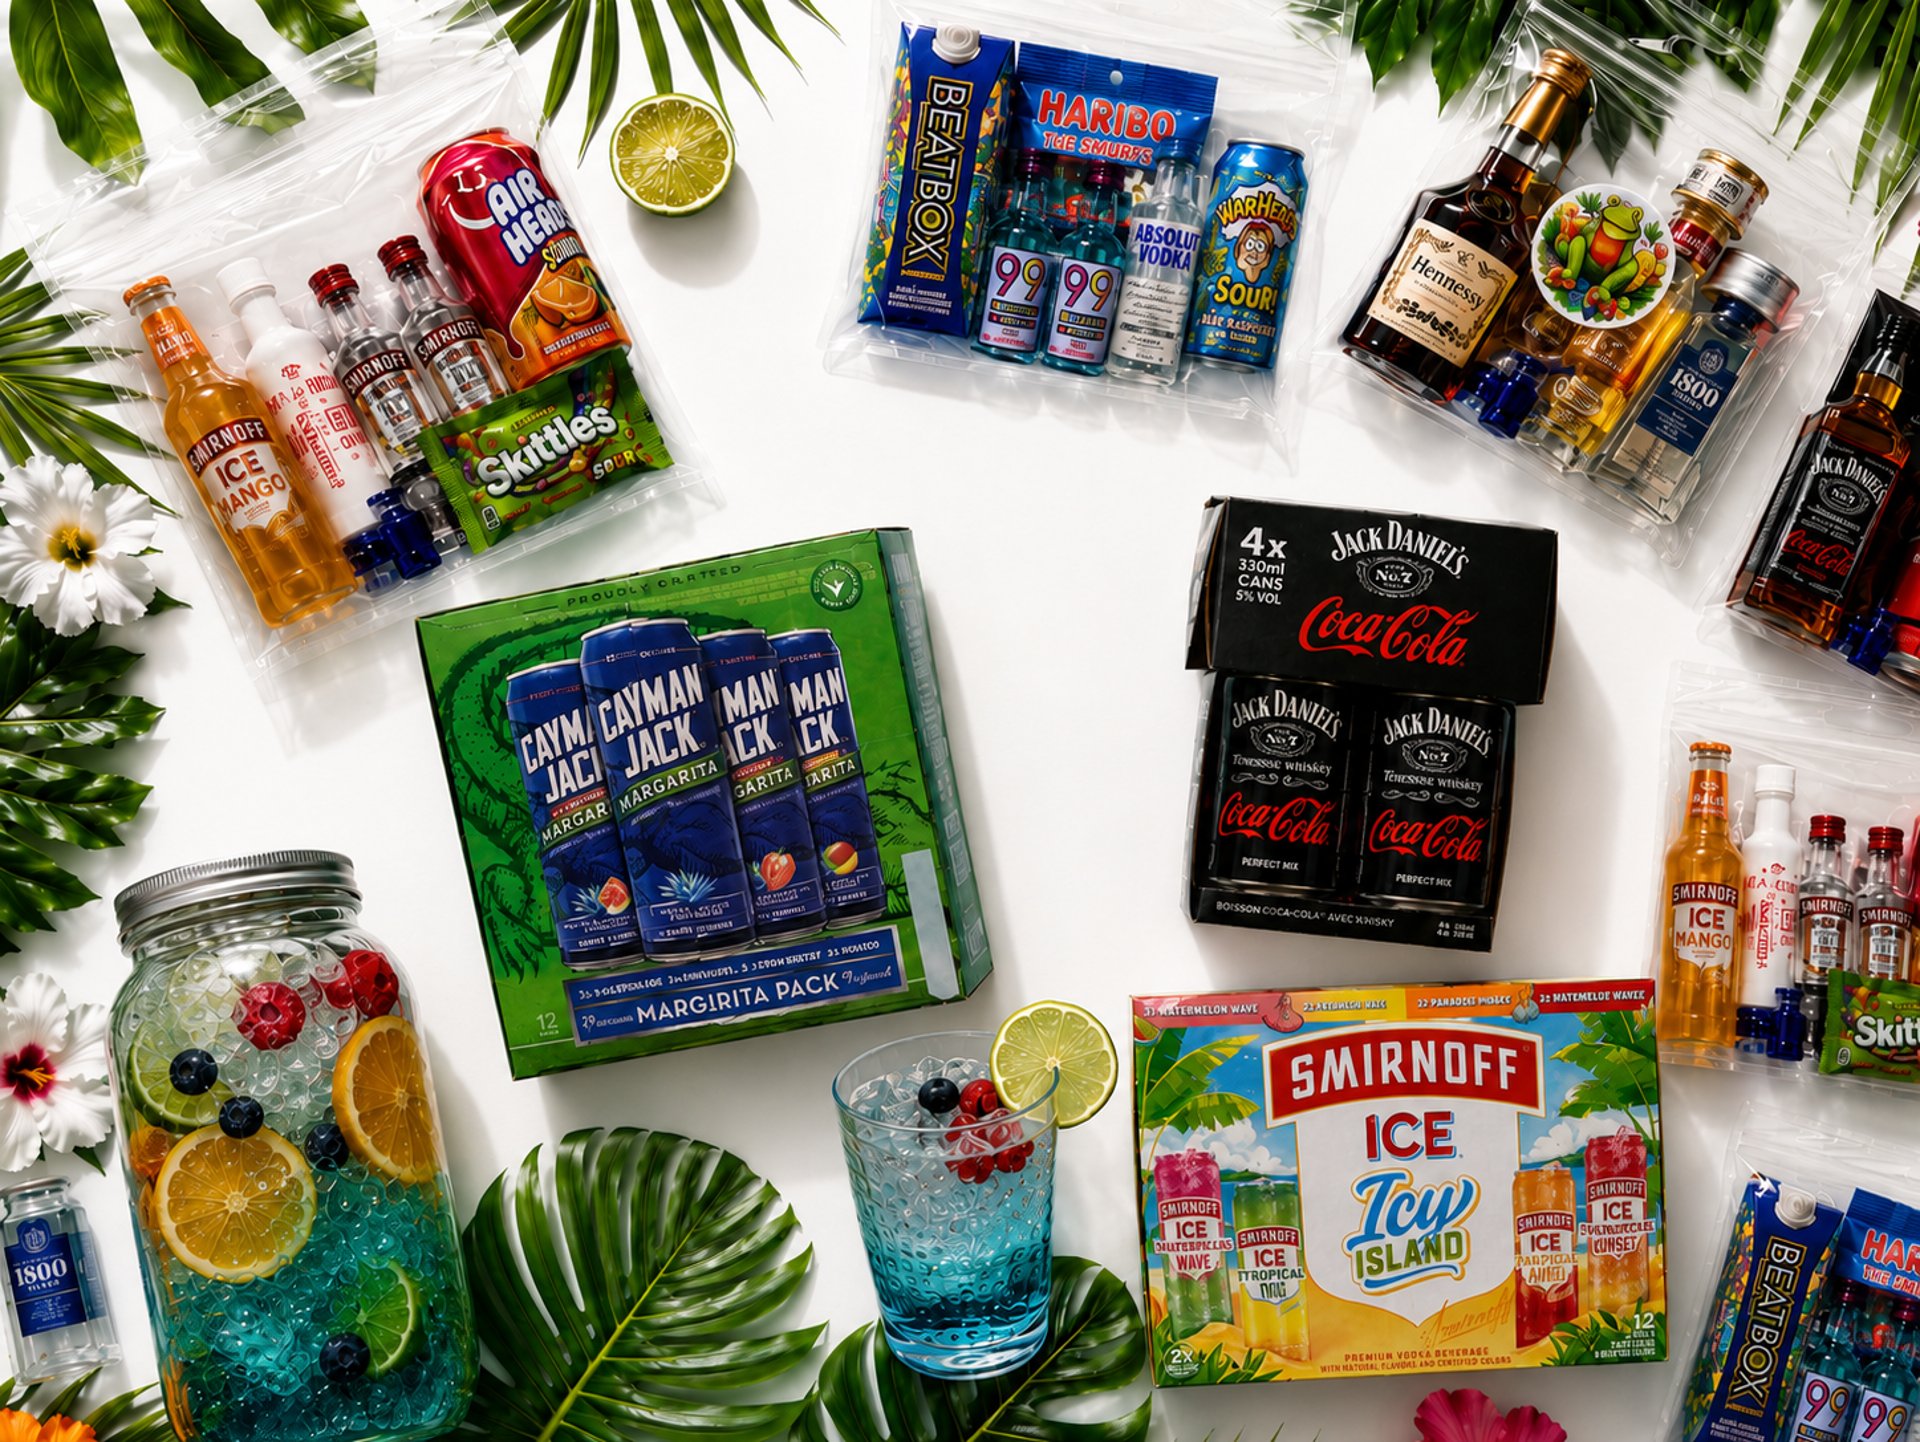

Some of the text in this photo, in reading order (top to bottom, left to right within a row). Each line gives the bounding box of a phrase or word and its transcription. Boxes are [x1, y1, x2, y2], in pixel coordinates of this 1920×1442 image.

[1038, 90, 1176, 143] HARIBO
[907, 82, 969, 269] BEATBOX
[488, 170, 545, 226] AIR
[1135, 222, 1200, 250] ABSOLUT
[995, 254, 1046, 302] 99
[1138, 245, 1191, 272] VODKA
[1064, 263, 1114, 311] 99
[1410, 255, 1486, 312] Hennessy
[418, 320, 480, 361] SMIRNOFF
[345, 350, 406, 393] SMIRNOFF
[1668, 366, 1721, 409] 1800
[189, 420, 266, 473] SMIRNOFF
[477, 405, 618, 497] Skittles
[592, 450, 637, 480] SOUR
[1810, 453, 1844, 476] JACK
[215, 449, 265, 490] ICE
[216, 473, 287, 520] MANGO
[1240, 527, 1288, 559] 4x
[1331, 519, 1470, 579] JACK DANIEL'S
[1238, 558, 1286, 576] 330ml
[1238, 574, 1284, 592] CANS
[1235, 589, 1283, 606] 5% VOL
[1298, 596, 1480, 667] Coca-Cola
[598, 663, 704, 744] CAYMAN
[718, 668, 781, 725] MAN
[788, 667, 845, 719] MAN
[1232, 689, 1343, 742] JACK DANIEL'S
[1383, 706, 1494, 758] JACK DANIEL'S
[520, 703, 596, 775] CAYM
[624, 712, 701, 780] JACK
[619, 759, 719, 814] MARGARITA
[733, 767, 794, 799] GARITA
[804, 758, 857, 788] ARITA
[541, 801, 610, 845] MARGAR
[1217, 791, 1337, 846] Coca-Cola
[1369, 809, 1490, 863] Coca-Cola
[1216, 901, 1261, 915] BOISSON
[1327, 912, 1354, 925] AVEC
[1672, 884, 1738, 903] SMIRNOFF
[1675, 930, 1732, 949] MANGO
[1688, 908, 1726, 930] ICE
[775, 972, 840, 1000] PACK
[535, 1011, 558, 1031] 12
[1854, 1015, 1920, 1048] Skitt
[1290, 1040, 1518, 1101] SMIRNOFF
[1365, 1110, 1455, 1161] ICE
[1161, 1202, 1218, 1218] SMIRNOFF
[1176, 1221, 1208, 1239] ICE
[1347, 1173, 1474, 1249] Icy
[1602, 1201, 1633, 1221] ICE
[1240, 1229, 1297, 1244] SMIRNOFF
[1253, 1248, 1286, 1267] ICE
[1355, 1229, 1464, 1280] ISLAND
[1531, 1233, 1561, 1252] ICE
[1862, 1228, 1920, 1275] HAR
[14, 1258, 68, 1287] 1800
[1176, 1253, 1211, 1270] WAVE
[1633, 1312, 1656, 1330] 12
[1733, 1241, 1801, 1400] BEATBOX
[1804, 1378, 1849, 1428] 99
[1862, 1397, 1908, 1442] 99
